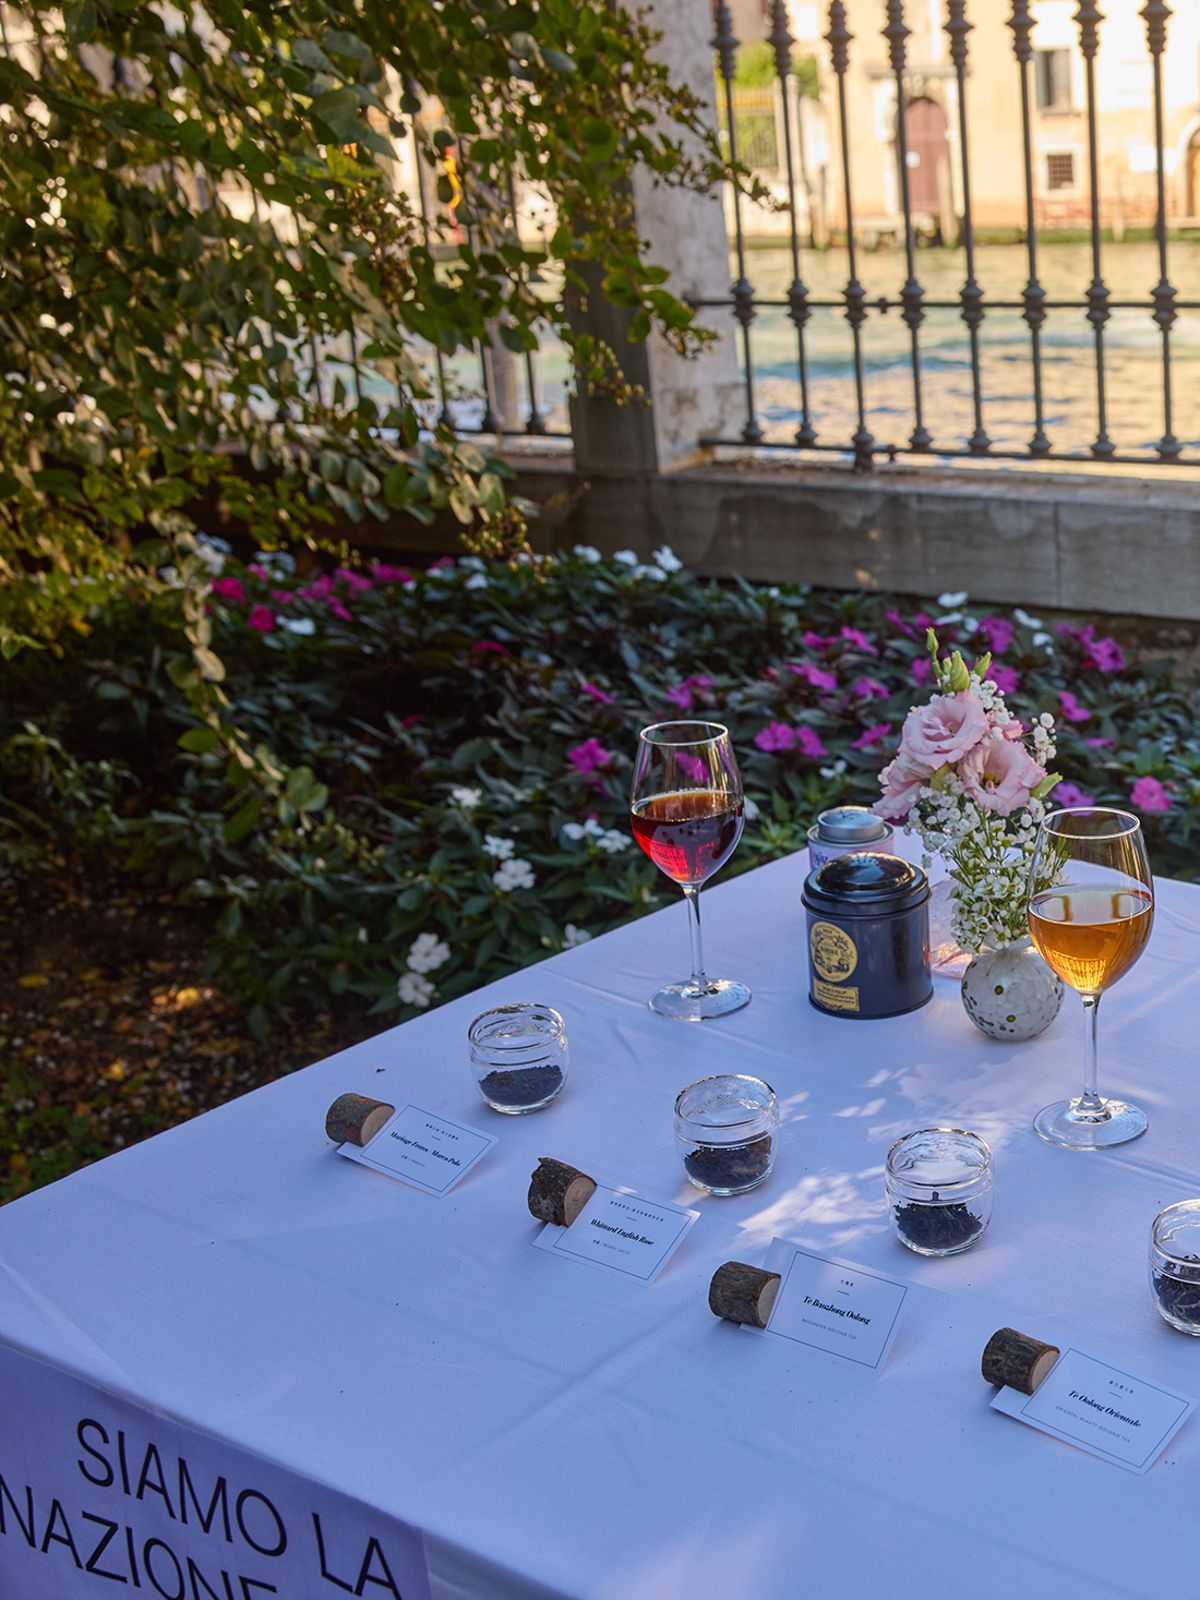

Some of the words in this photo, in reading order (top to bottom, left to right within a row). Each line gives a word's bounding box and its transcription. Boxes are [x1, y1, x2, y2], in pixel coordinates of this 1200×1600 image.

[1104, 1407, 1142, 1428] Orientale
[77, 1418, 288, 1557] SIAMO
[311, 1512, 402, 1600] LA
